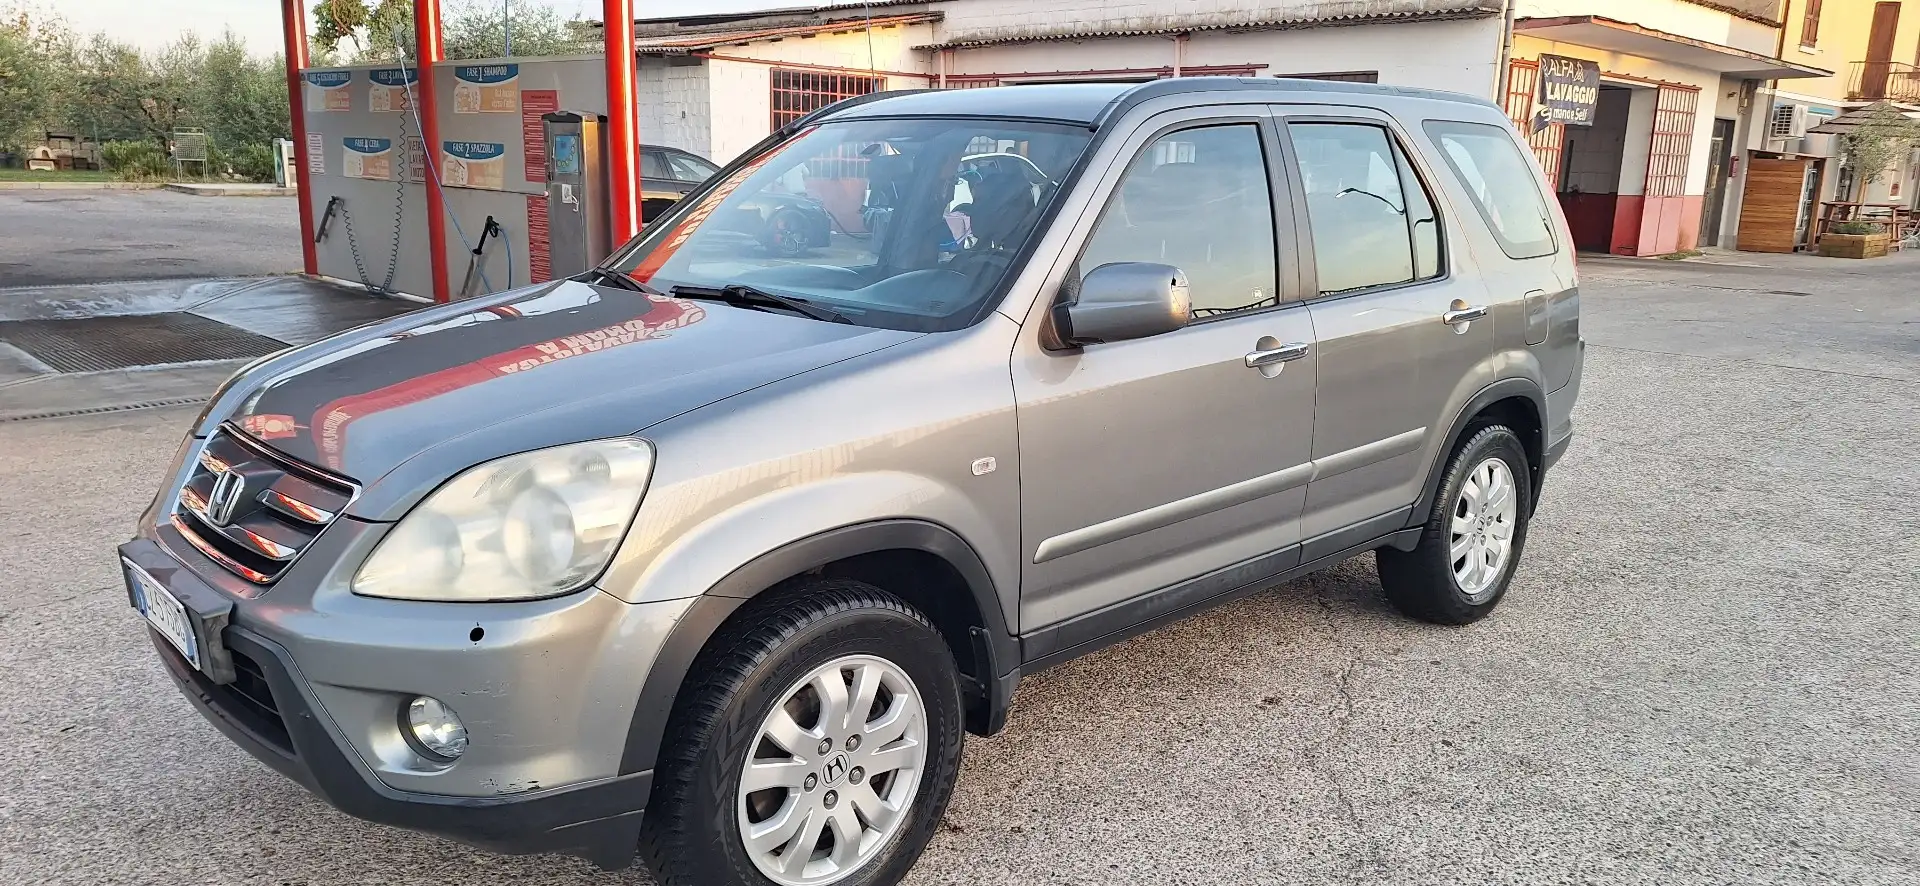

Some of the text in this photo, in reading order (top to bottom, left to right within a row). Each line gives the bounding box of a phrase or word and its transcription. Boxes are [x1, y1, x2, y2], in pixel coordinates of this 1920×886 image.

[466, 67, 478, 77] FASE
[1548, 58, 1574, 79] ALFA
[1546, 81, 1596, 105] LAVAGGIO
[1575, 107, 1588, 121] Self
[452, 143, 464, 152] FASE
[470, 143, 495, 154] SPAZZOLA
